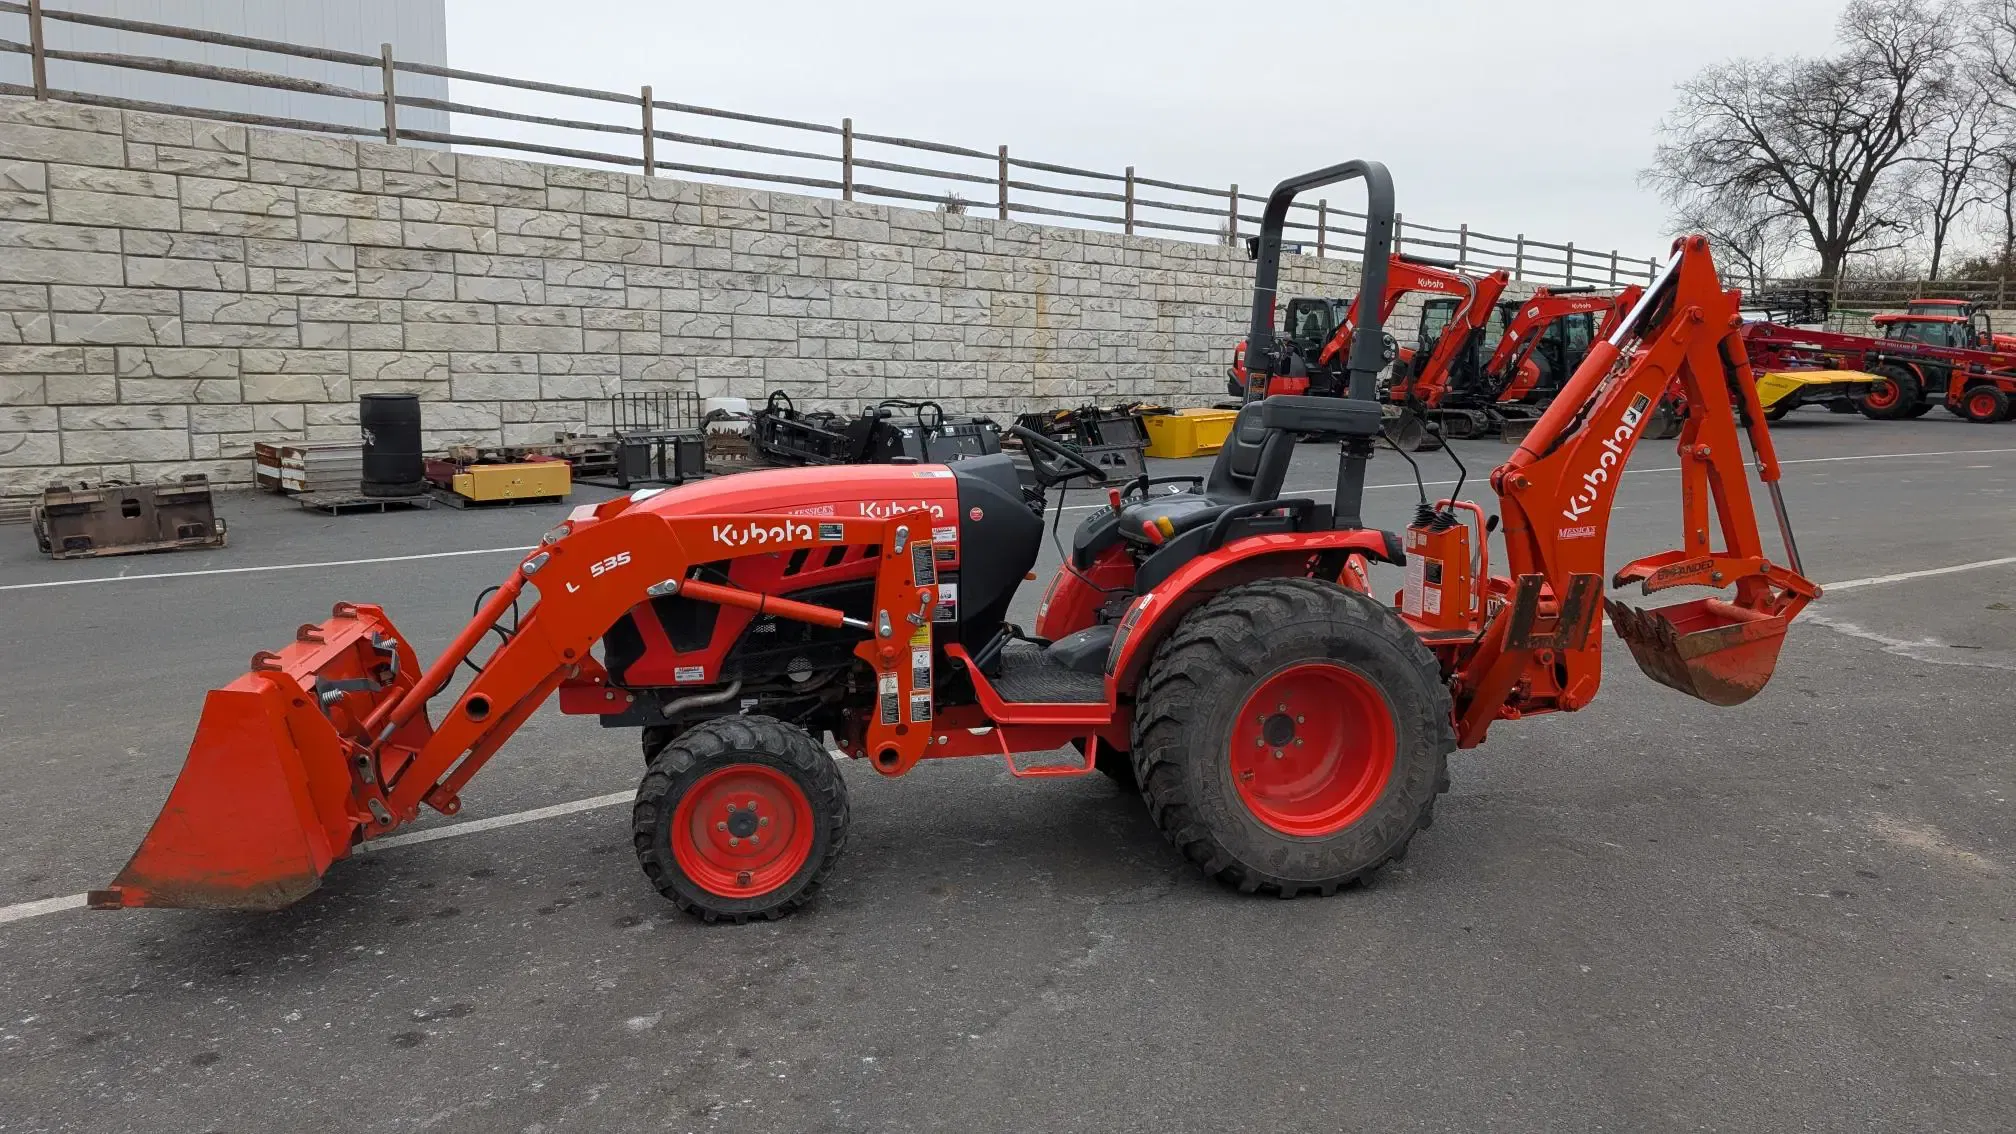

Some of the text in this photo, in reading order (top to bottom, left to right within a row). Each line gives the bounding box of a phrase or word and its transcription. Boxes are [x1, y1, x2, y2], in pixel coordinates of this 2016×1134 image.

[1417, 278, 1444, 288] Kubota
[1562, 425, 1634, 521] Kubota
[712, 519, 813, 547] Kubota
[590, 551, 632, 578] 535
